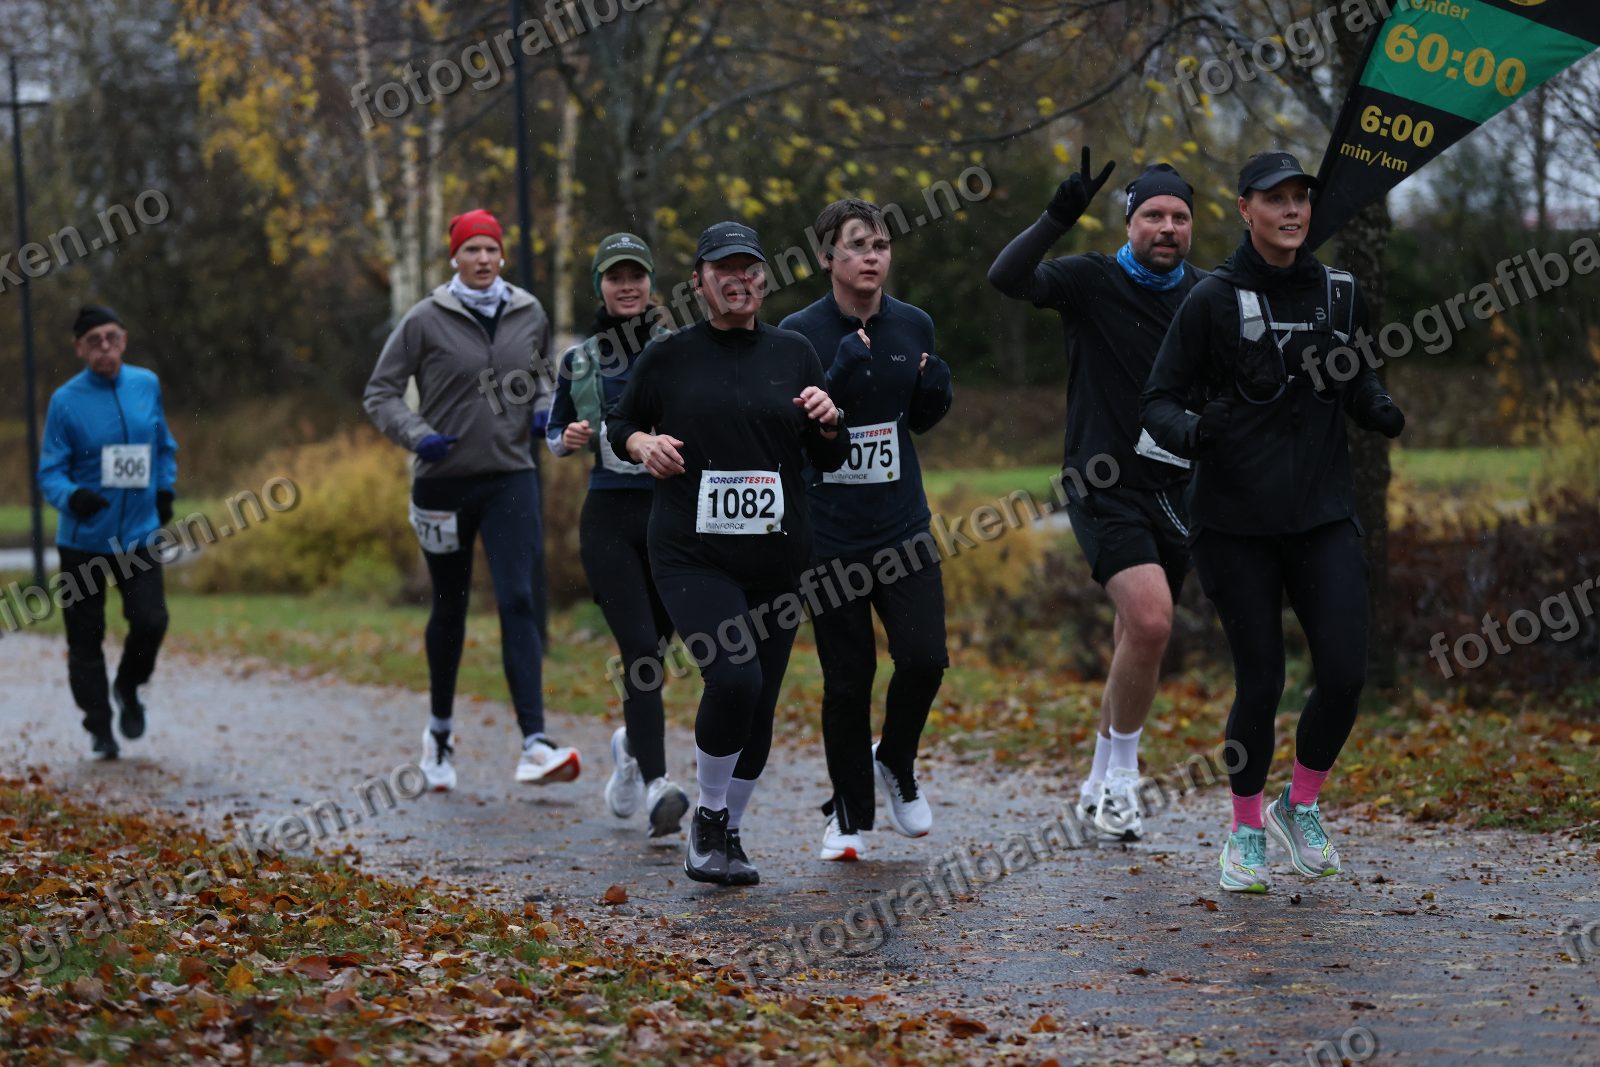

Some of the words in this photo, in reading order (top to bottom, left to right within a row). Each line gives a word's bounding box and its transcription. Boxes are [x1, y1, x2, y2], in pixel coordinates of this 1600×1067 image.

[1385, 24, 1526, 97] 60:00
[1361, 105, 1435, 148] 6:00
[1340, 143, 1408, 172] min/km
[113, 456, 146, 479] 506
[707, 476, 776, 485] NORGESTESTEN
[708, 488, 776, 519] 1082
[705, 522, 745, 530] WINFORCE
